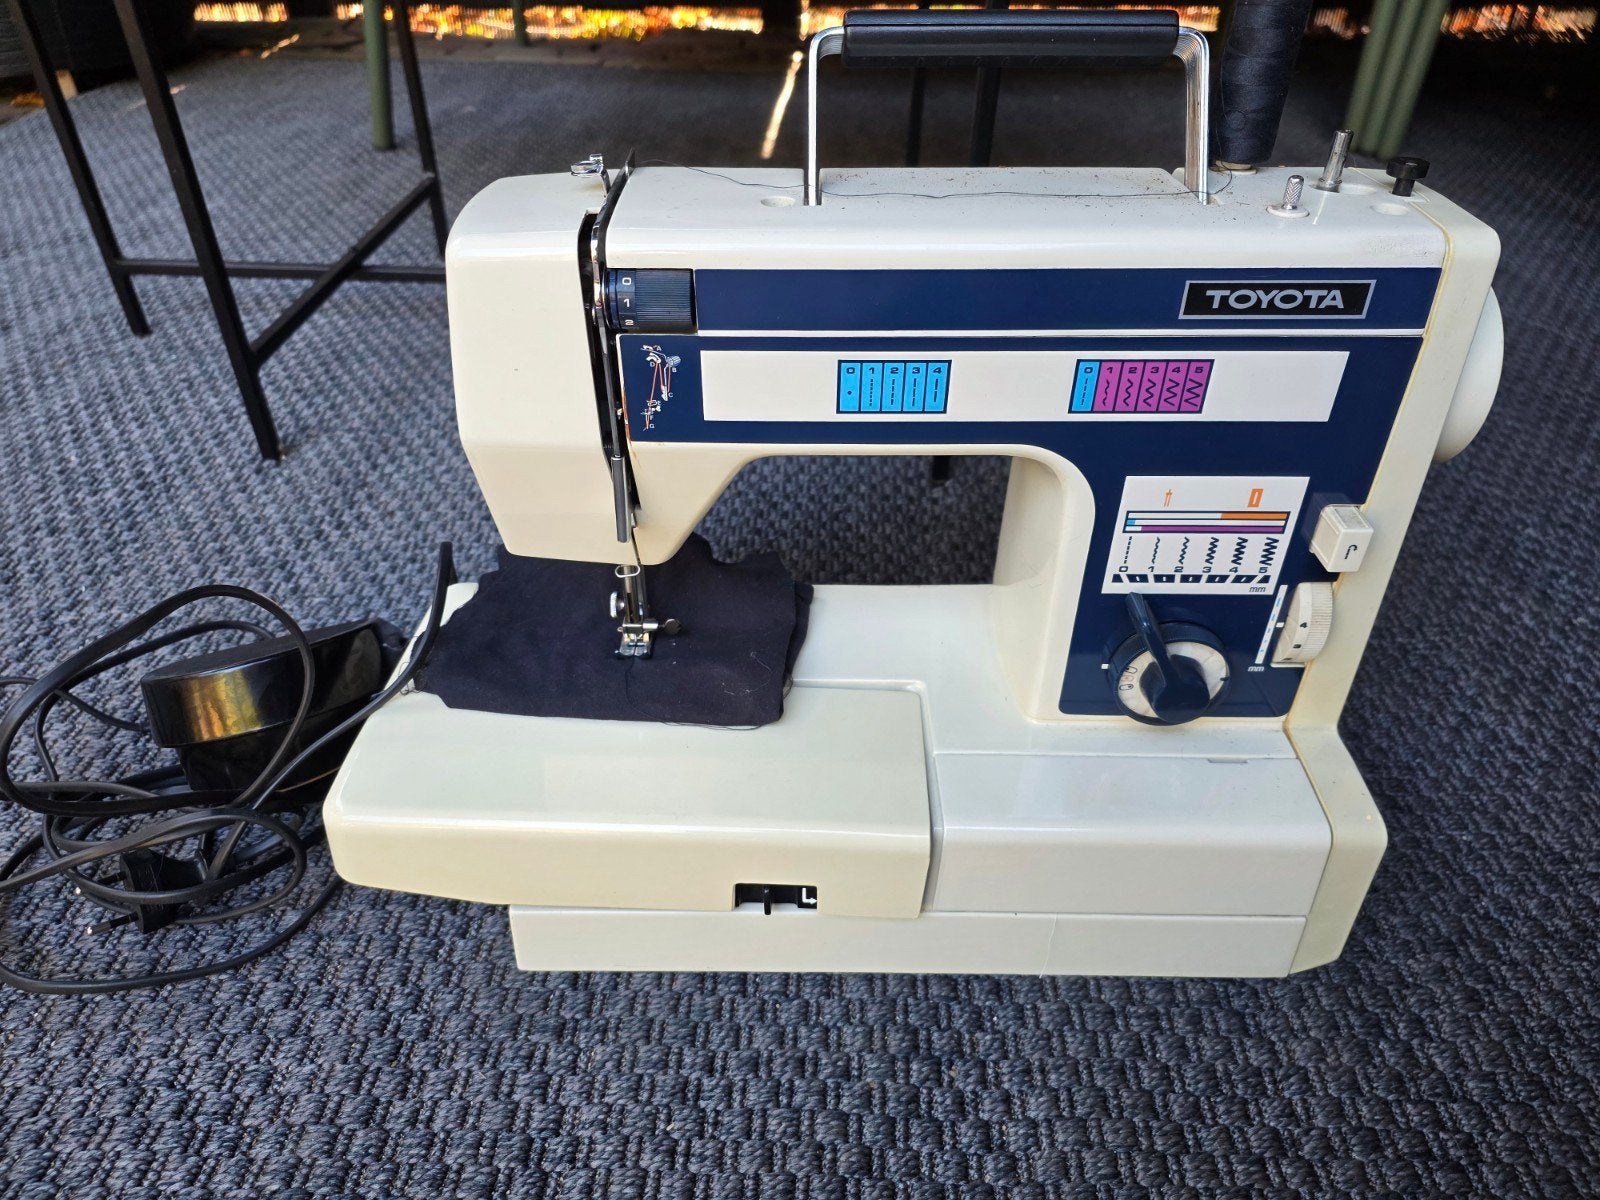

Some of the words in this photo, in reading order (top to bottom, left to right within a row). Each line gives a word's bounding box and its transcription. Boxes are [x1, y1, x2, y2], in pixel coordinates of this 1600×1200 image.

[621, 277, 632, 286] 0
[623, 298, 630, 308] 1
[1205, 289, 1345, 309] TOYOTA
[846, 367, 856, 375] 0
[868, 367, 875, 375] 1
[890, 367, 899, 375] 2
[911, 367, 921, 375] 3
[933, 367, 942, 375] 4
[1083, 366, 1093, 374] 0
[1106, 366, 1113, 374] 1
[1128, 366, 1137, 374] 2
[1150, 366, 1160, 374] 3
[1171, 366, 1181, 374] 4
[1194, 366, 1204, 374] 5
[1299, 621, 1308, 629] 4
